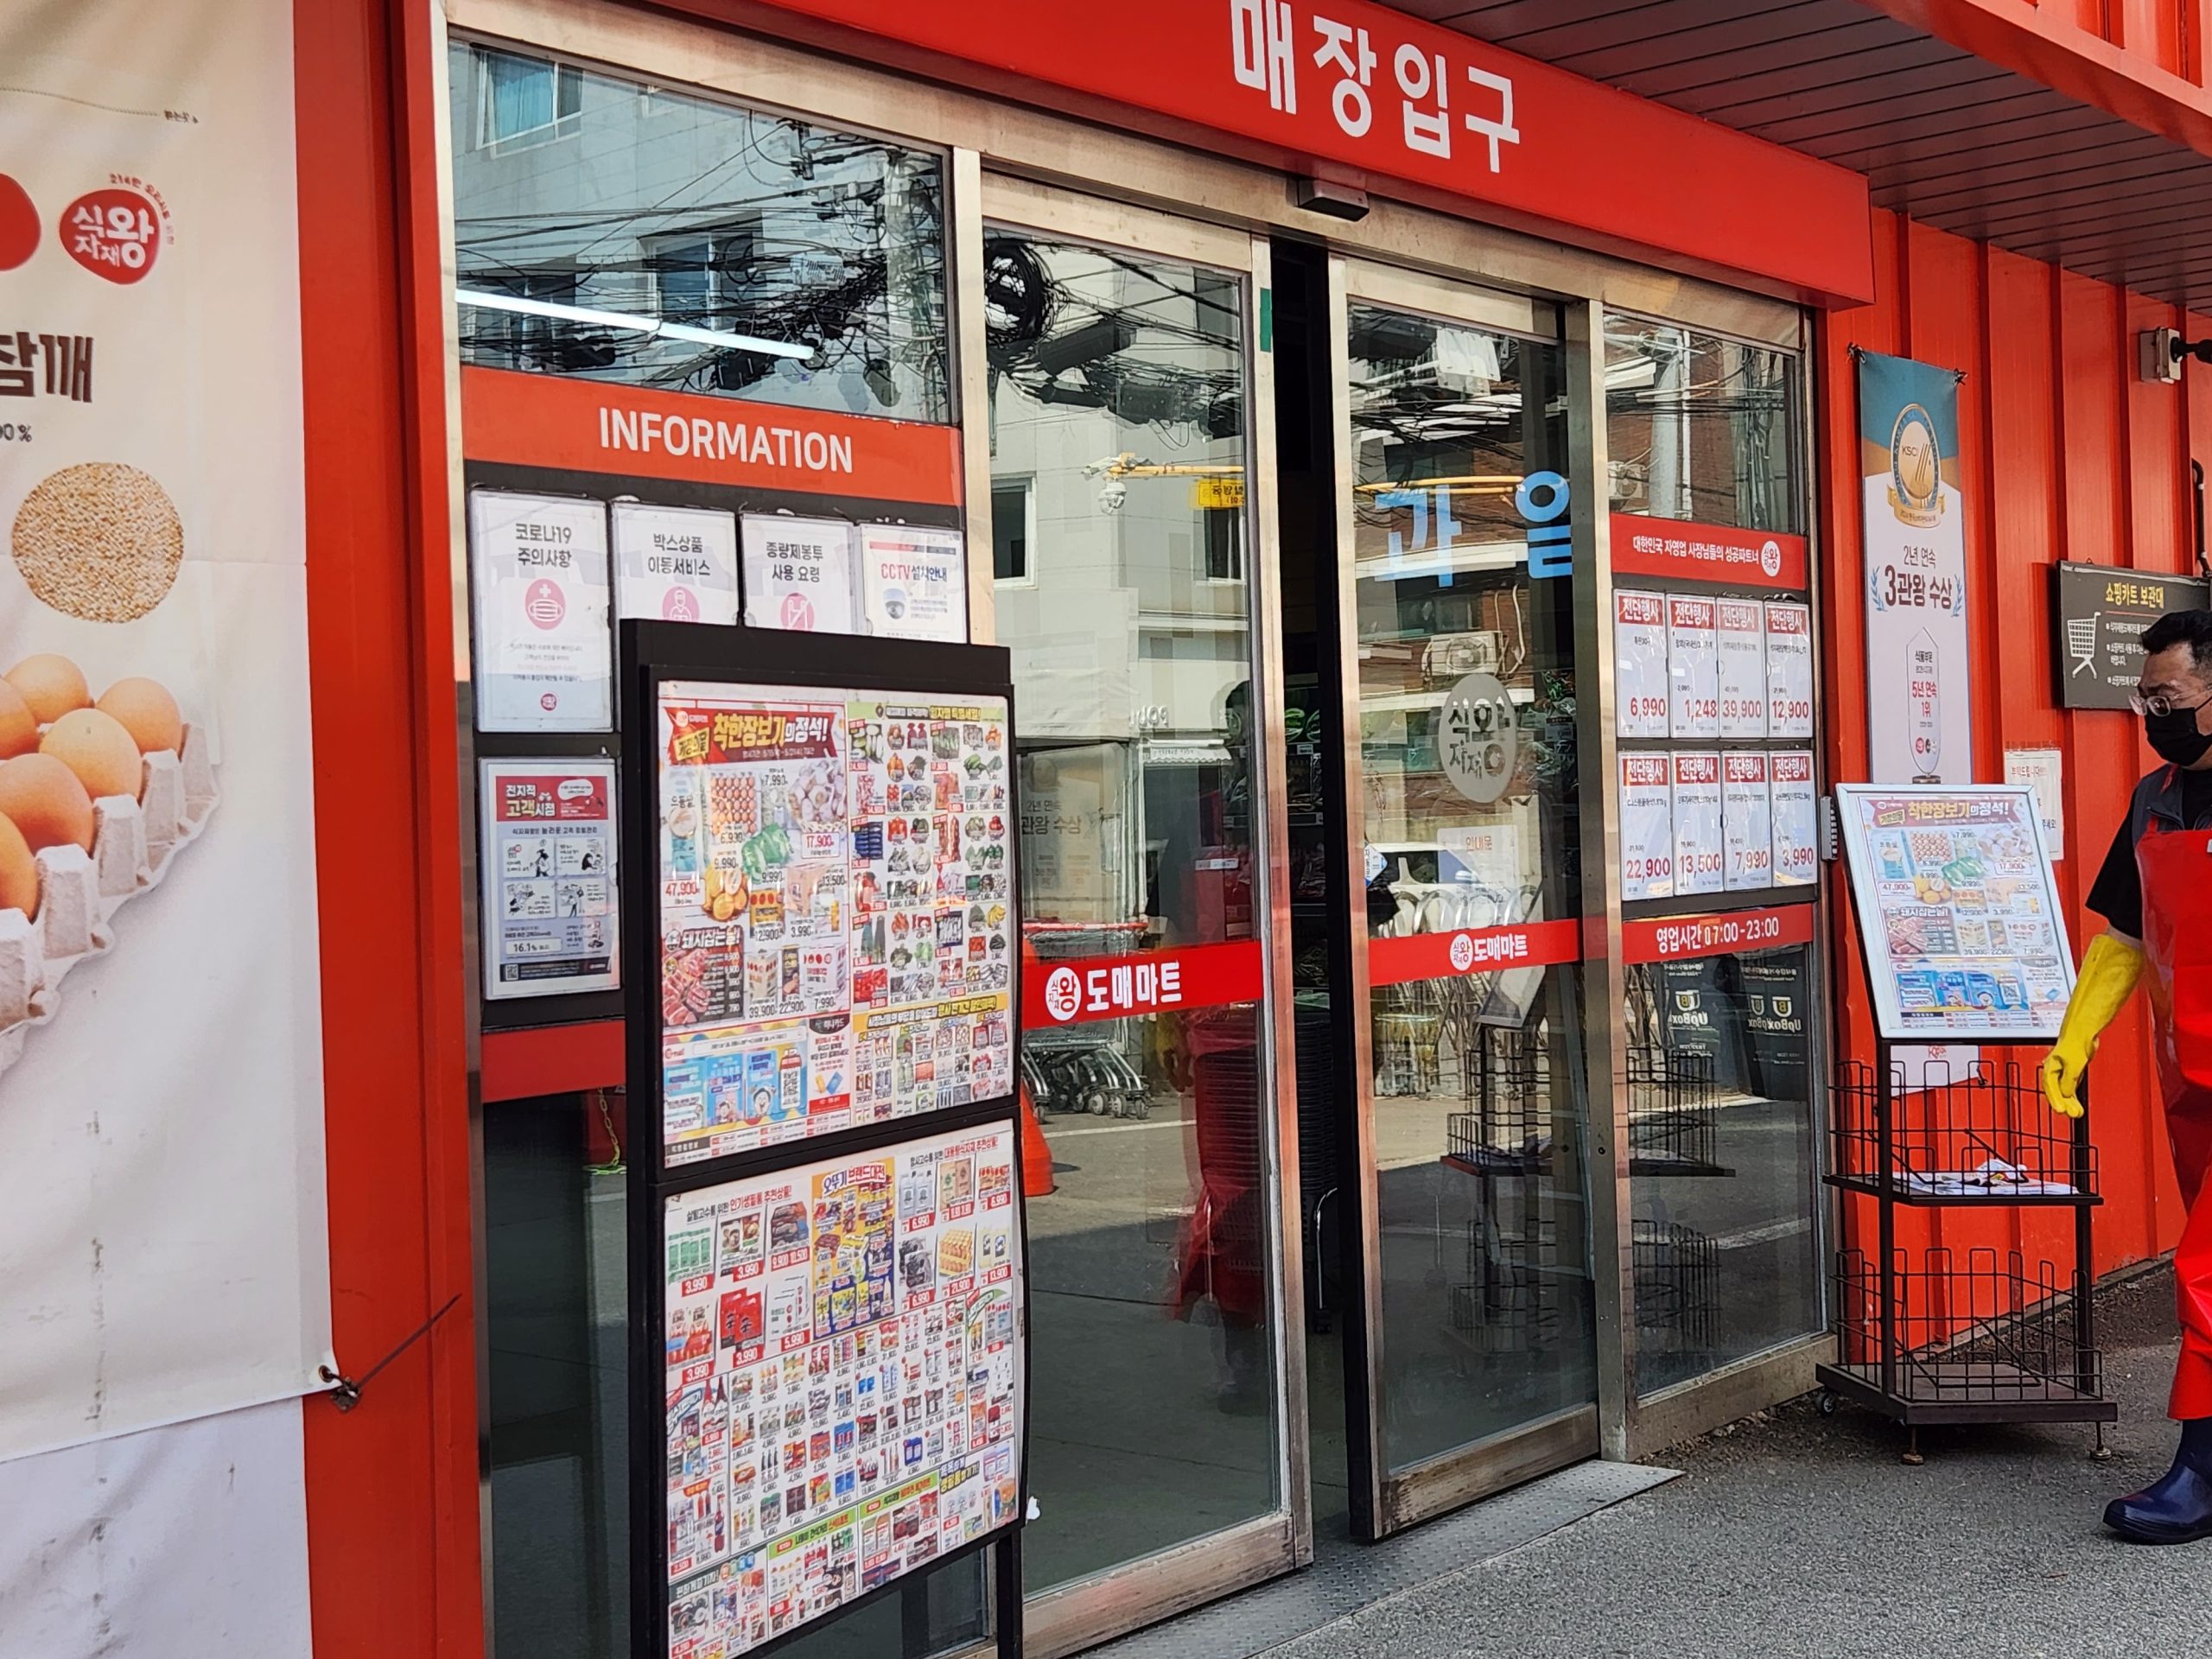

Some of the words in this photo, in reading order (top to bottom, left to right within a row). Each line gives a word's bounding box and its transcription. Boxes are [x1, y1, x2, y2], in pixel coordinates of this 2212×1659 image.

[600, 406, 853, 474] INFORMATION
[516, 523, 571, 543] 코로나19
[653, 533, 702, 553] 박스상품
[518, 547, 571, 568] 주의사항
[766, 542, 823, 562] 종량제봉투
[1633, 536, 1663, 555] 대한민국
[1664, 539, 1687, 556] 자영업
[1688, 542, 1724, 561] 사장님들의
[1725, 548, 1759, 565] 성공파트너
[1904, 545, 1918, 566] 2년
[1921, 549, 1936, 569] 연속
[648, 556, 710, 576] 이동서비스
[772, 564, 793, 582] 사용
[798, 566, 820, 582] 요령
[1885, 564, 1925, 607] 3관왕
[1929, 576, 1952, 610] 수상
[2105, 582, 2138, 606] 쇼핑카트
[2140, 586, 2164, 609] 보관대
[1623, 597, 1659, 624] 전단행사
[1675, 601, 1710, 627] 전단행사
[1722, 606, 1755, 630] 전단행사
[1770, 609, 1802, 633] 전단행사
[1630, 696, 1666, 722] 6,990
[1685, 698, 1717, 723] 1,248
[1722, 700, 1761, 724] 39,900
[1772, 700, 1809, 725] 12,900
[1628, 760, 1663, 783] 전단행사
[1679, 758, 1713, 781] 전단행사
[1727, 757, 1761, 779] 전단행사
[1776, 757, 1807, 779] 전단행사
[1626, 857, 1670, 883] 22,900
[1680, 854, 1720, 879] 13,500
[1735, 850, 1768, 874] 7,990
[1783, 848, 1814, 871] 3,990
[1474, 933, 1528, 962] 도매마트
[1656, 924, 1701, 954] 영업시간
[1086, 961, 1182, 1011] 도매마트
